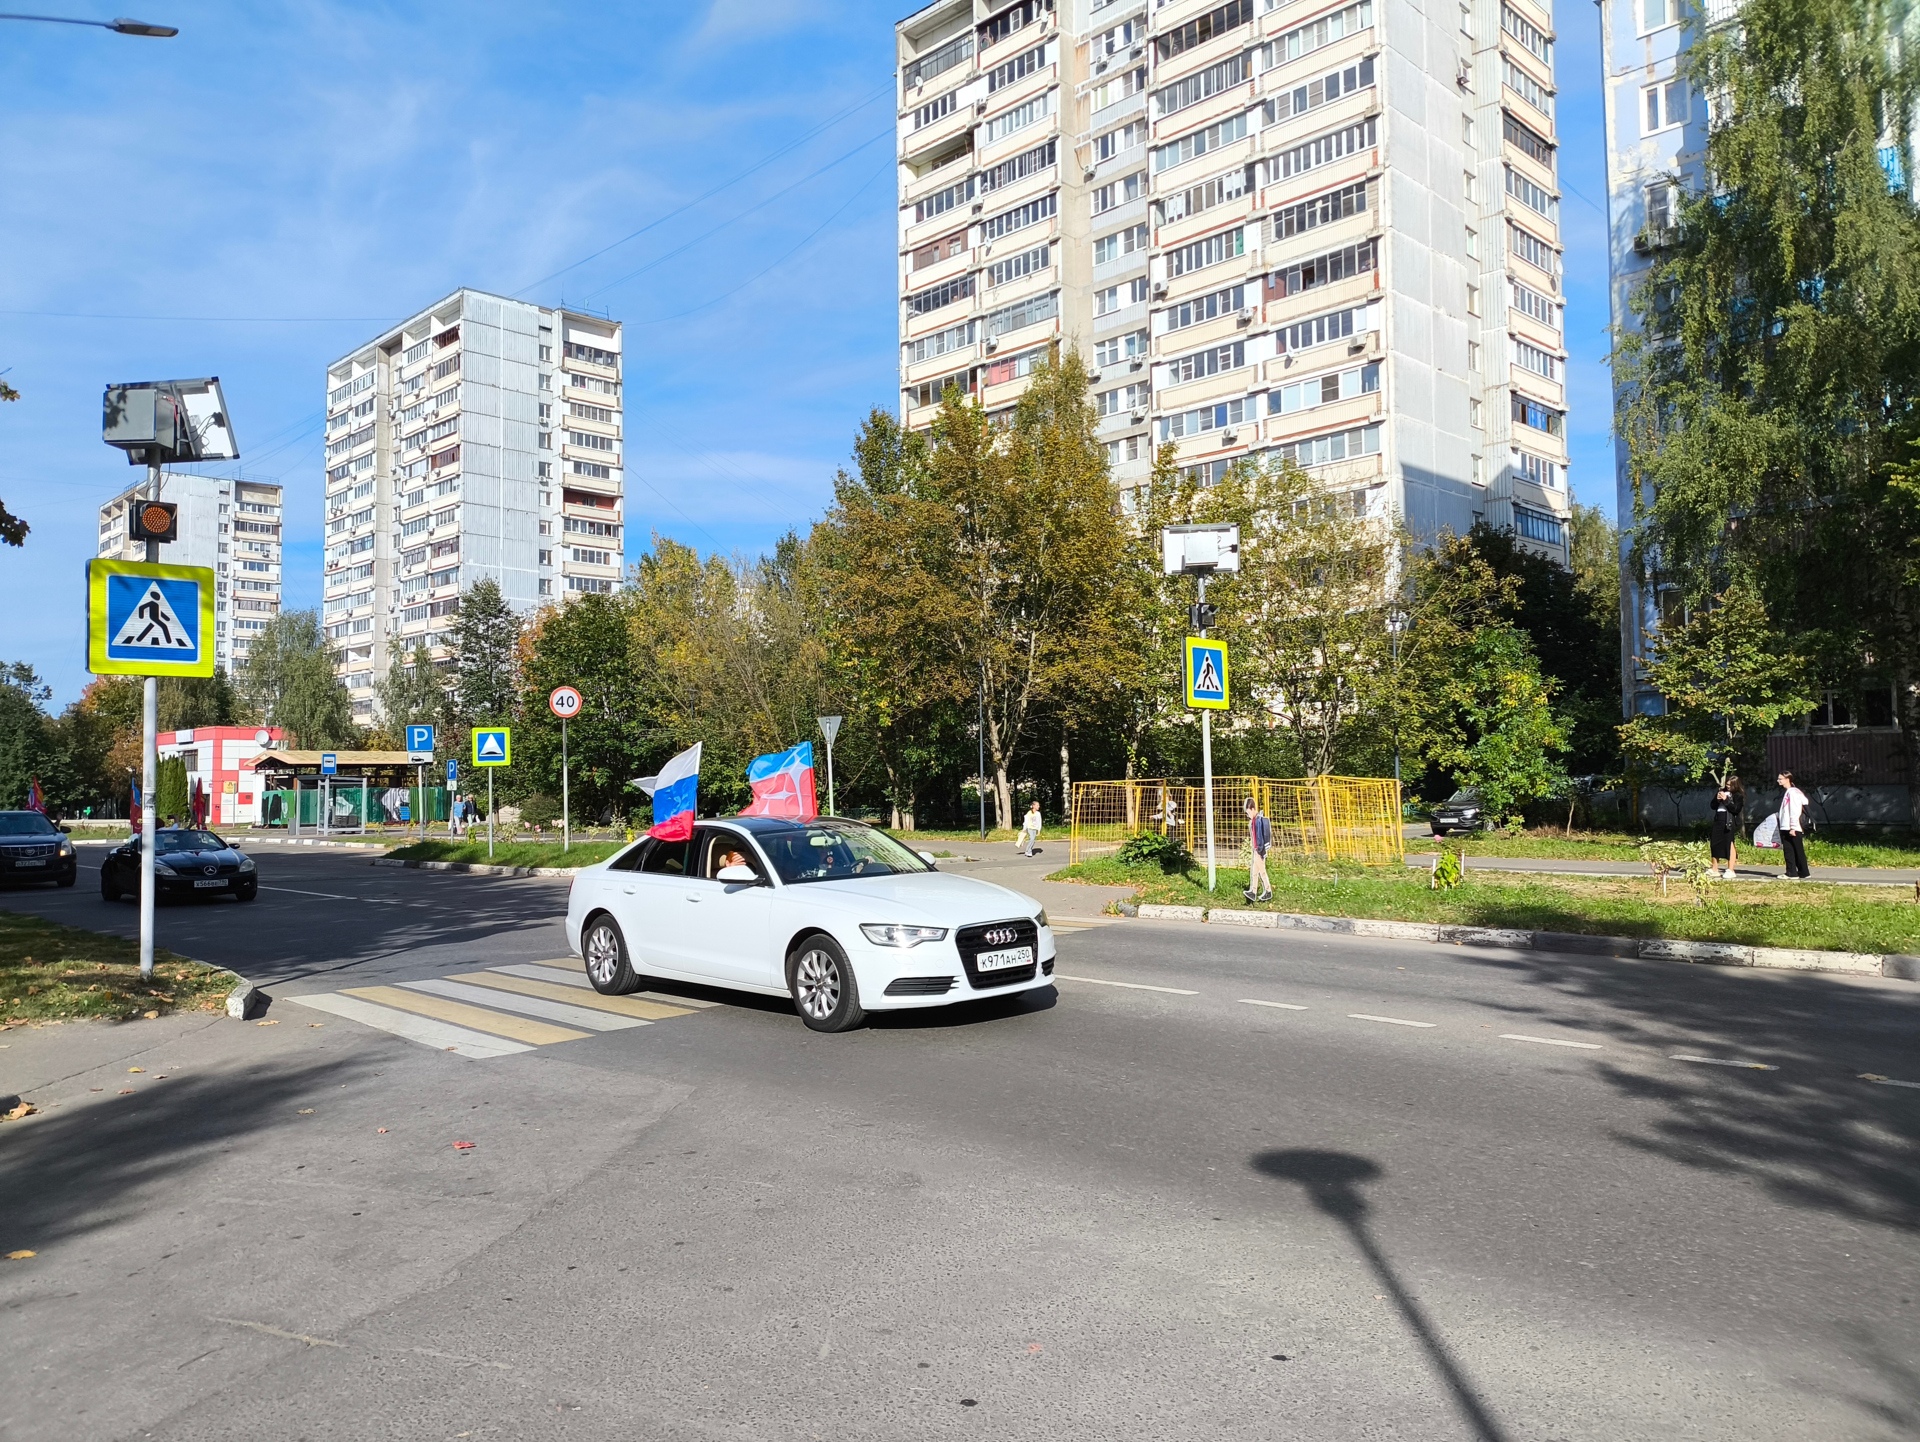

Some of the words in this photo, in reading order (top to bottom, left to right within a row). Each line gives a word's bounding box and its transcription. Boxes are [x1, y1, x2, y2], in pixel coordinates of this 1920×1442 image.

[555, 695, 575, 708] 40
[413, 728, 428, 749] P
[448, 761, 455, 778] P
